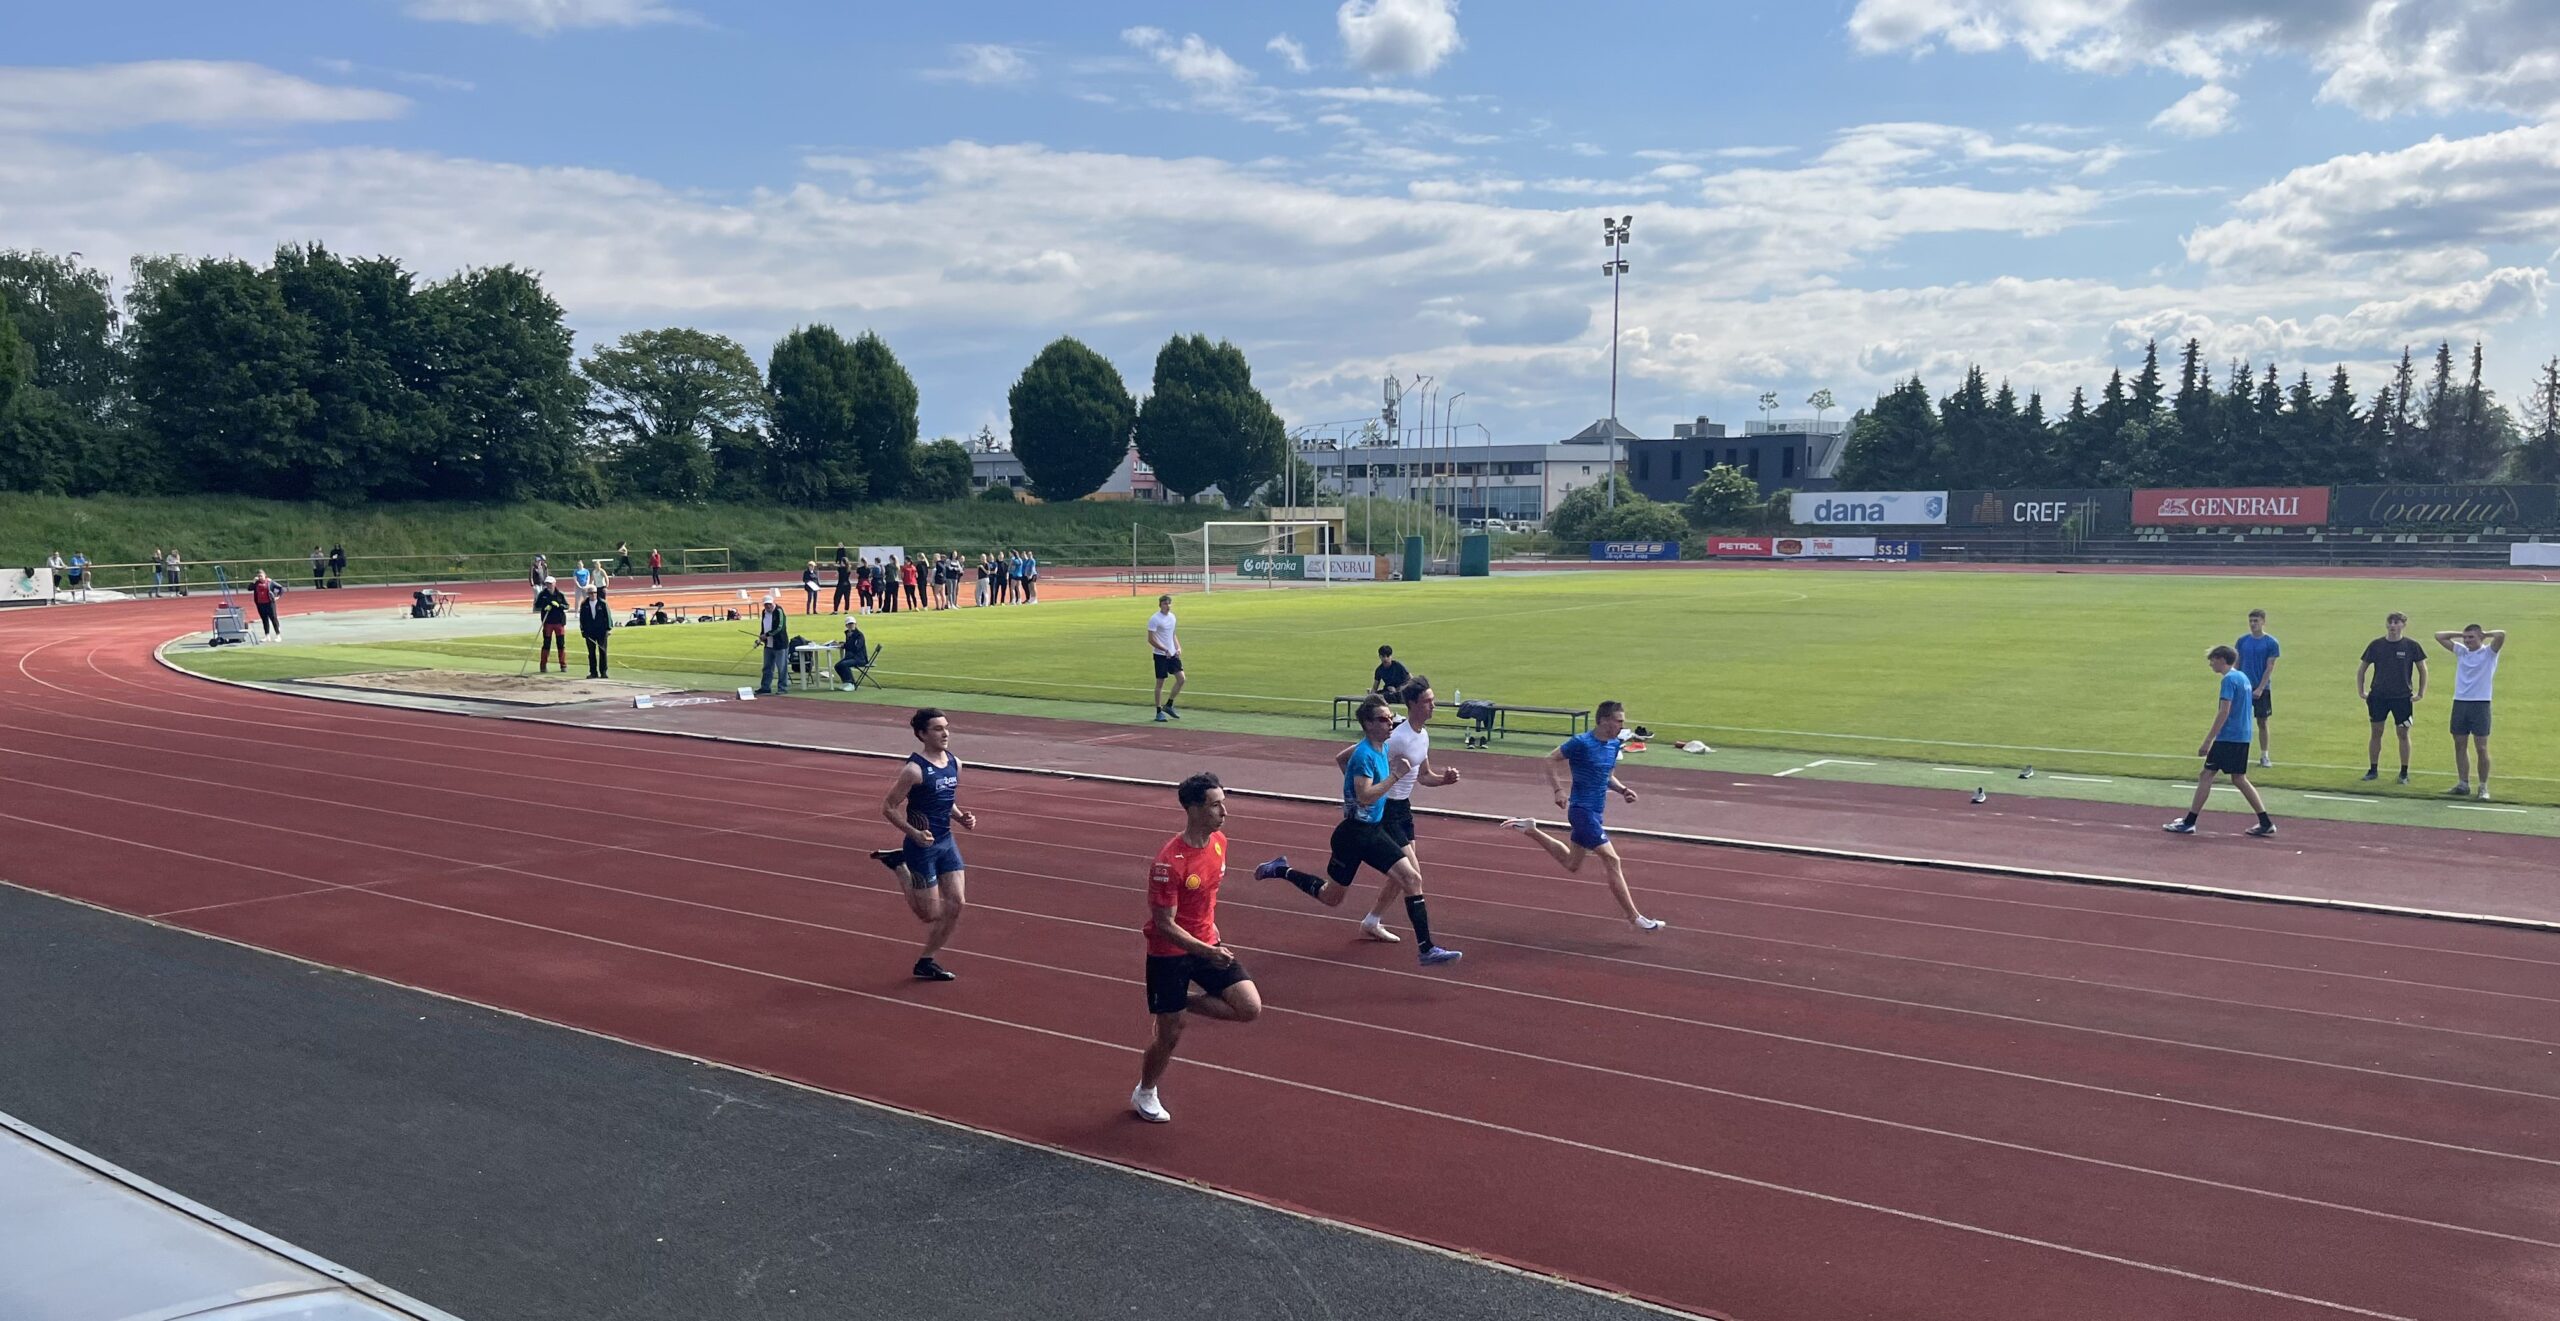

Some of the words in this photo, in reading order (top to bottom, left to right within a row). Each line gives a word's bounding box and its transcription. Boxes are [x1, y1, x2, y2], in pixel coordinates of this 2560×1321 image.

[1814, 499, 1885, 522] dana
[2013, 502, 2067, 522] CREF
[2191, 497, 2300, 516] GENERALI
[1606, 543, 1663, 553] MASS
[1718, 542, 1762, 551] PETROL
[1875, 541, 1908, 555] ss.si
